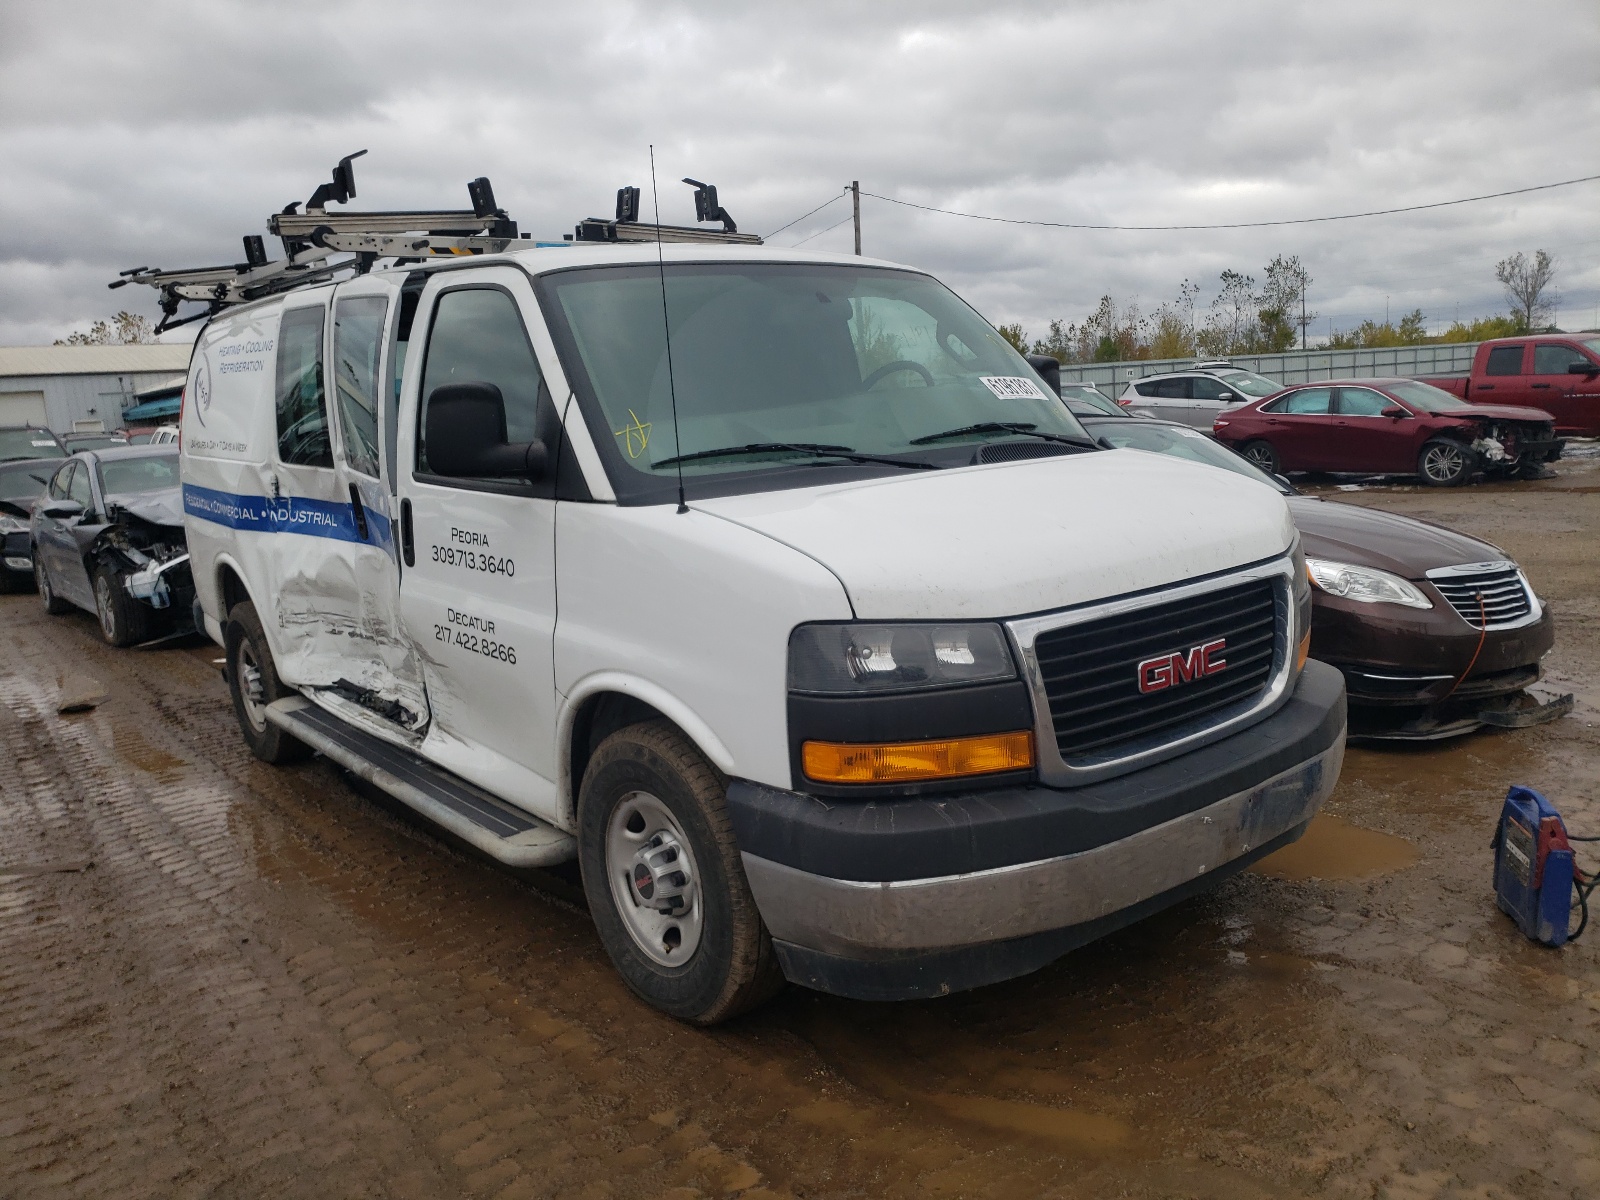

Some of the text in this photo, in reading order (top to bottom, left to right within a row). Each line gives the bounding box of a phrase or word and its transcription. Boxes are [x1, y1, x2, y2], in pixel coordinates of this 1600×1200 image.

[245, 340, 273, 354] COOLING
[219, 360, 264, 374] REFRIGERATION
[213, 500, 259, 521] COMMERCIAL
[451, 527, 490, 547] PEORIA
[432, 545, 515, 577] 309.713.3640
[447, 608, 496, 635] DECATUR
[434, 624, 517, 665] 217.422.8266
[1138, 638, 1227, 694] GMC
